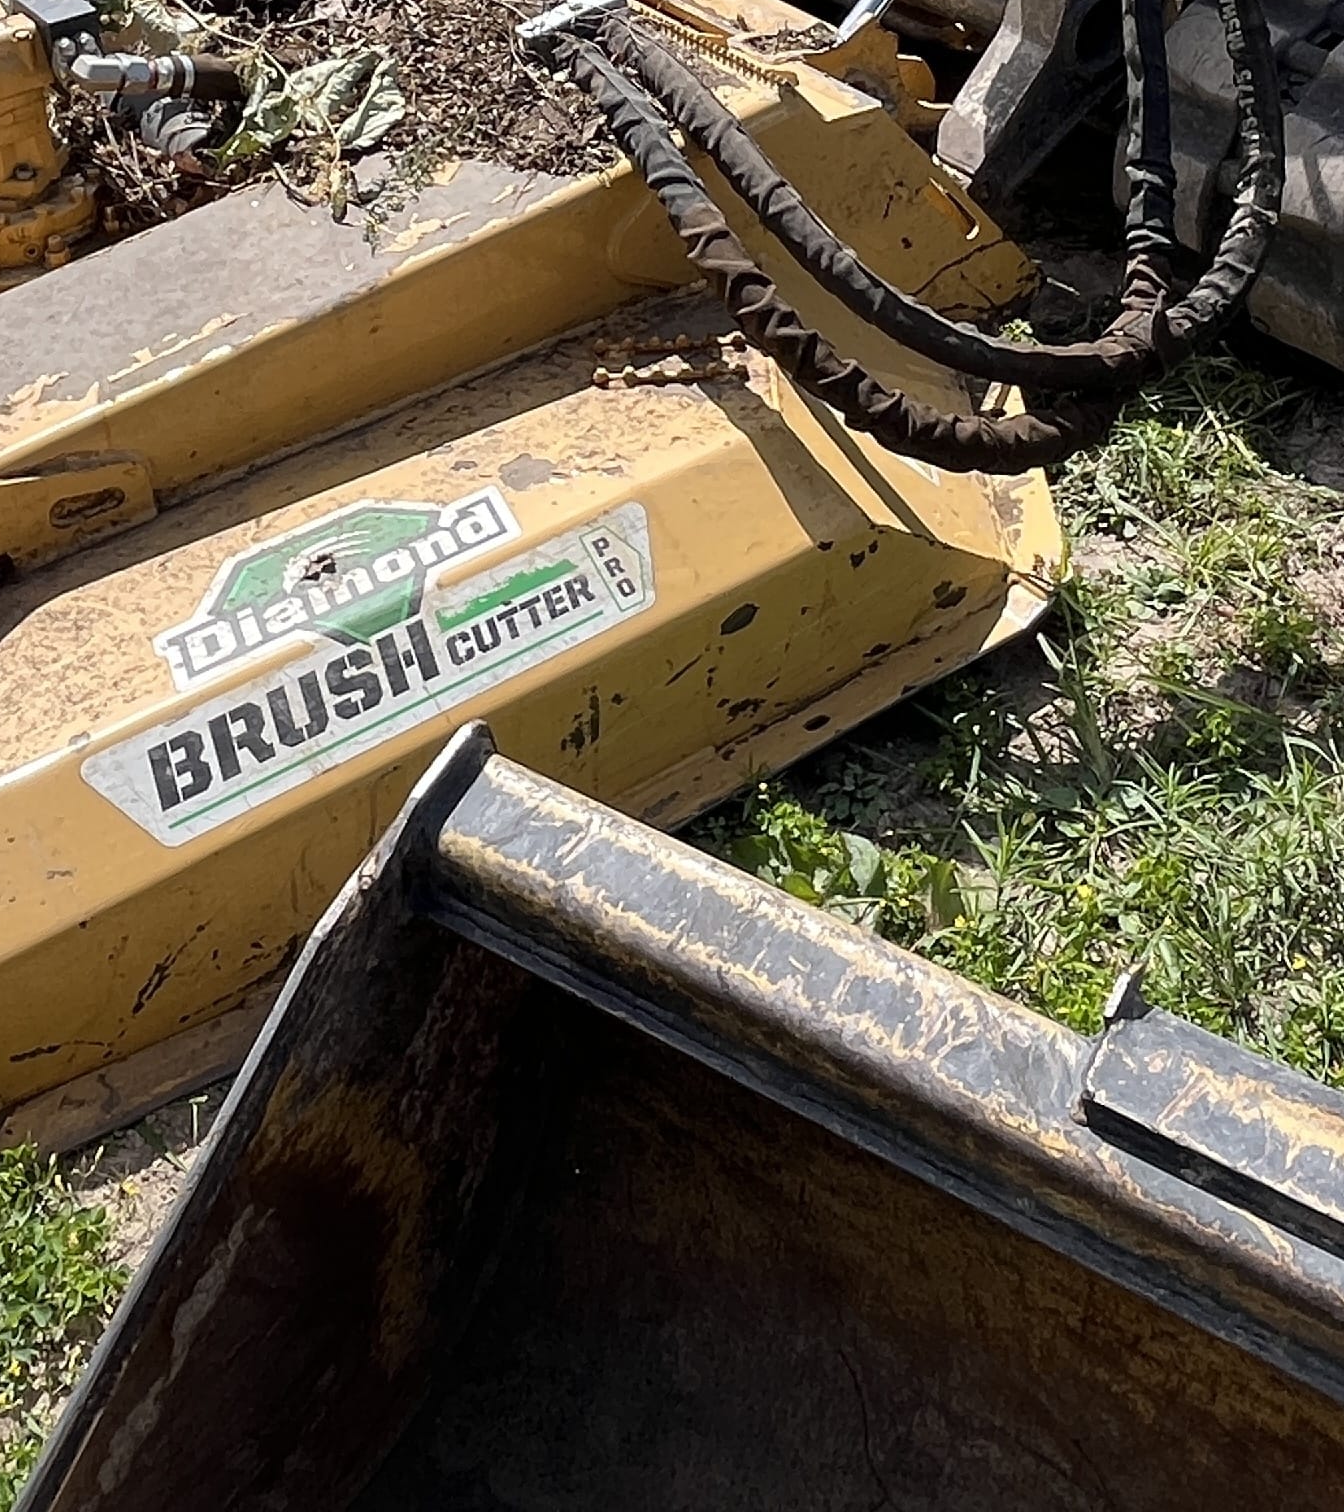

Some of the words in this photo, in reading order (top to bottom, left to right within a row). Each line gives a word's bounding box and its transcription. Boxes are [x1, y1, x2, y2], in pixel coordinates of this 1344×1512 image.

[179, 492, 508, 679] Diamond
[591, 536, 637, 599] PRO
[147, 619, 440, 813] BRUSH
[446, 572, 596, 666] CUTTER
